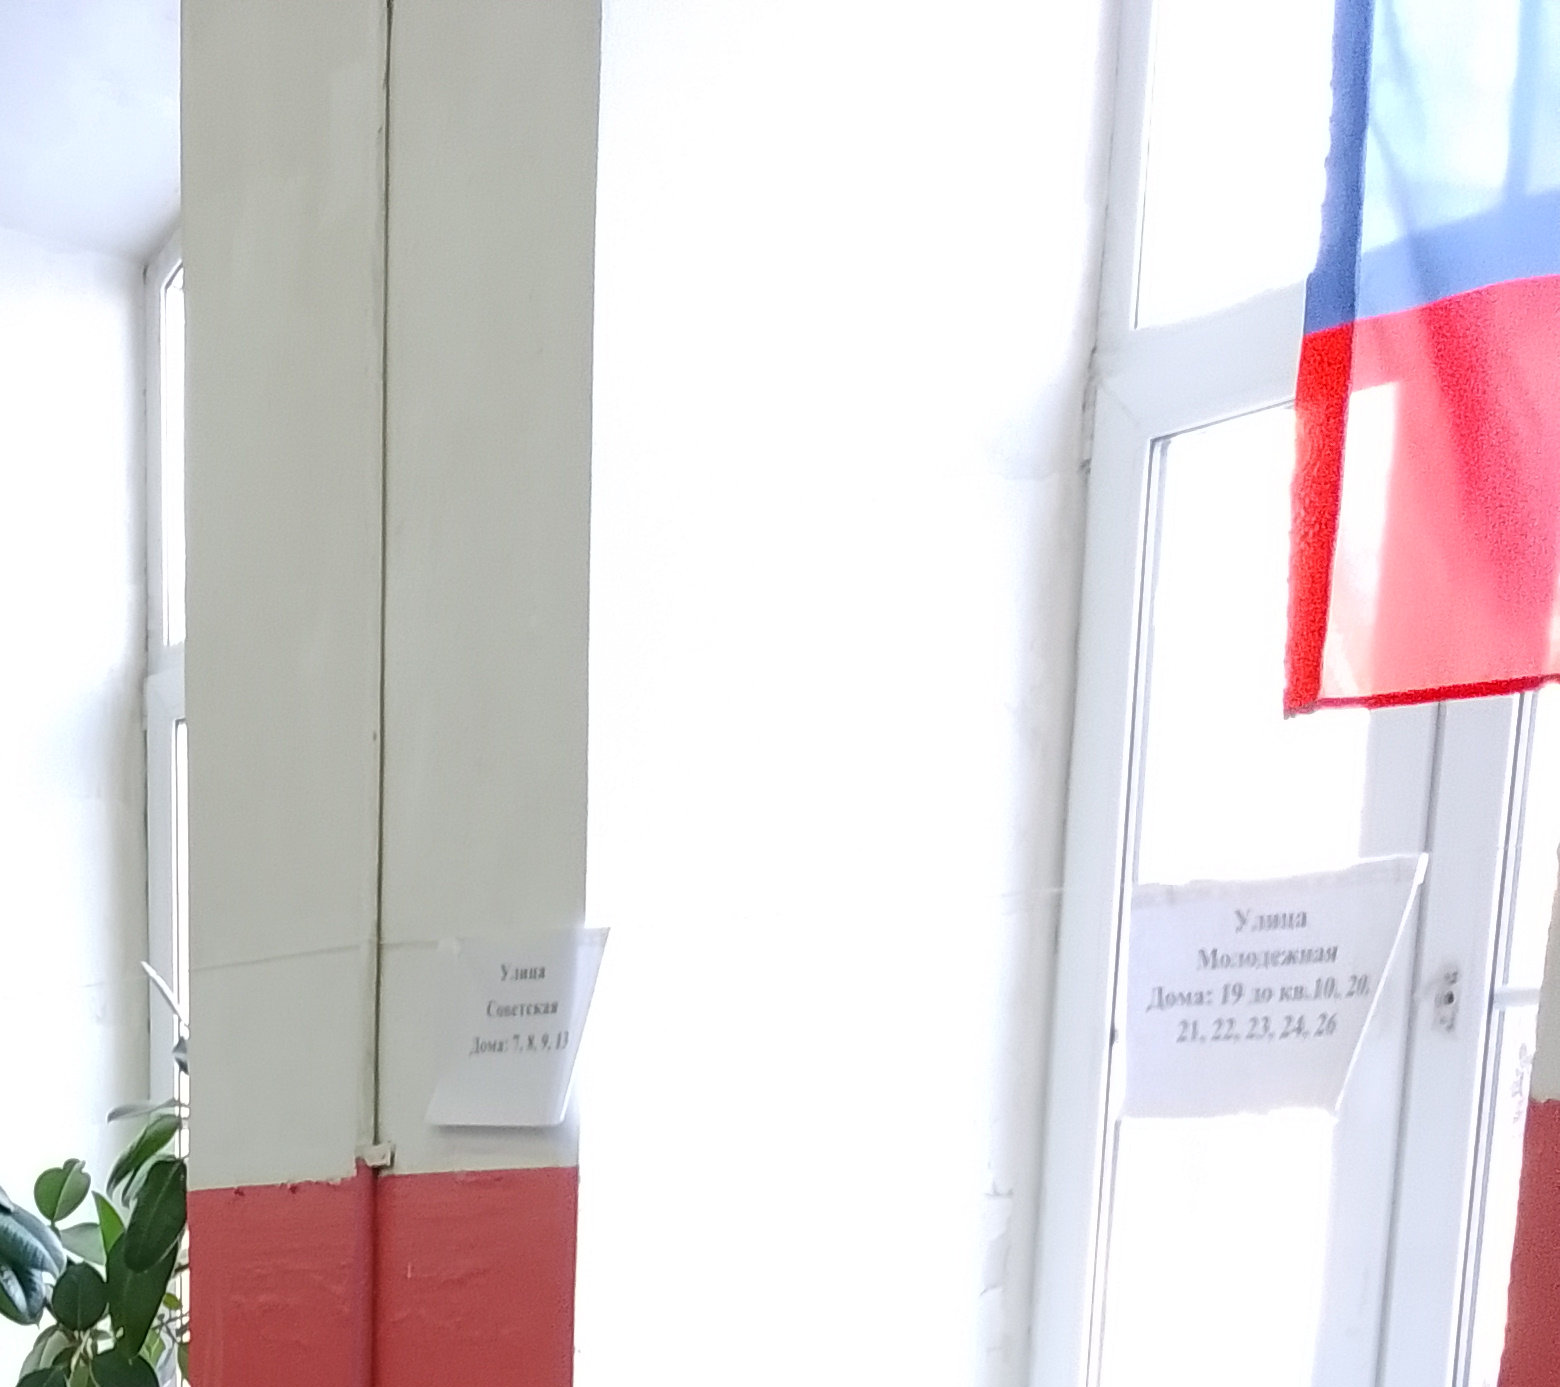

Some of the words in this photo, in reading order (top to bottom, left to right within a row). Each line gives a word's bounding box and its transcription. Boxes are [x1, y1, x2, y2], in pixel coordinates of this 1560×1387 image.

[1234, 907, 1309, 934] Улица
[1196, 944, 1339, 971] Молодежная
[500, 962, 546, 982] Улица
[486, 998, 559, 1018] Советская
[1145, 985, 1213, 1014] Дома:
[1220, 981, 1244, 1006] 19
[1248, 985, 1273, 1006] до
[1176, 1018, 1206, 1044] 21,
[1210, 1016, 1242, 1044] 22,
[1244, 1015, 1275, 1042] 23,
[1278, 1013, 1310, 1040] 24,
[1312, 1010, 1339, 1038] 26
[469, 1035, 509, 1057] Дома:
